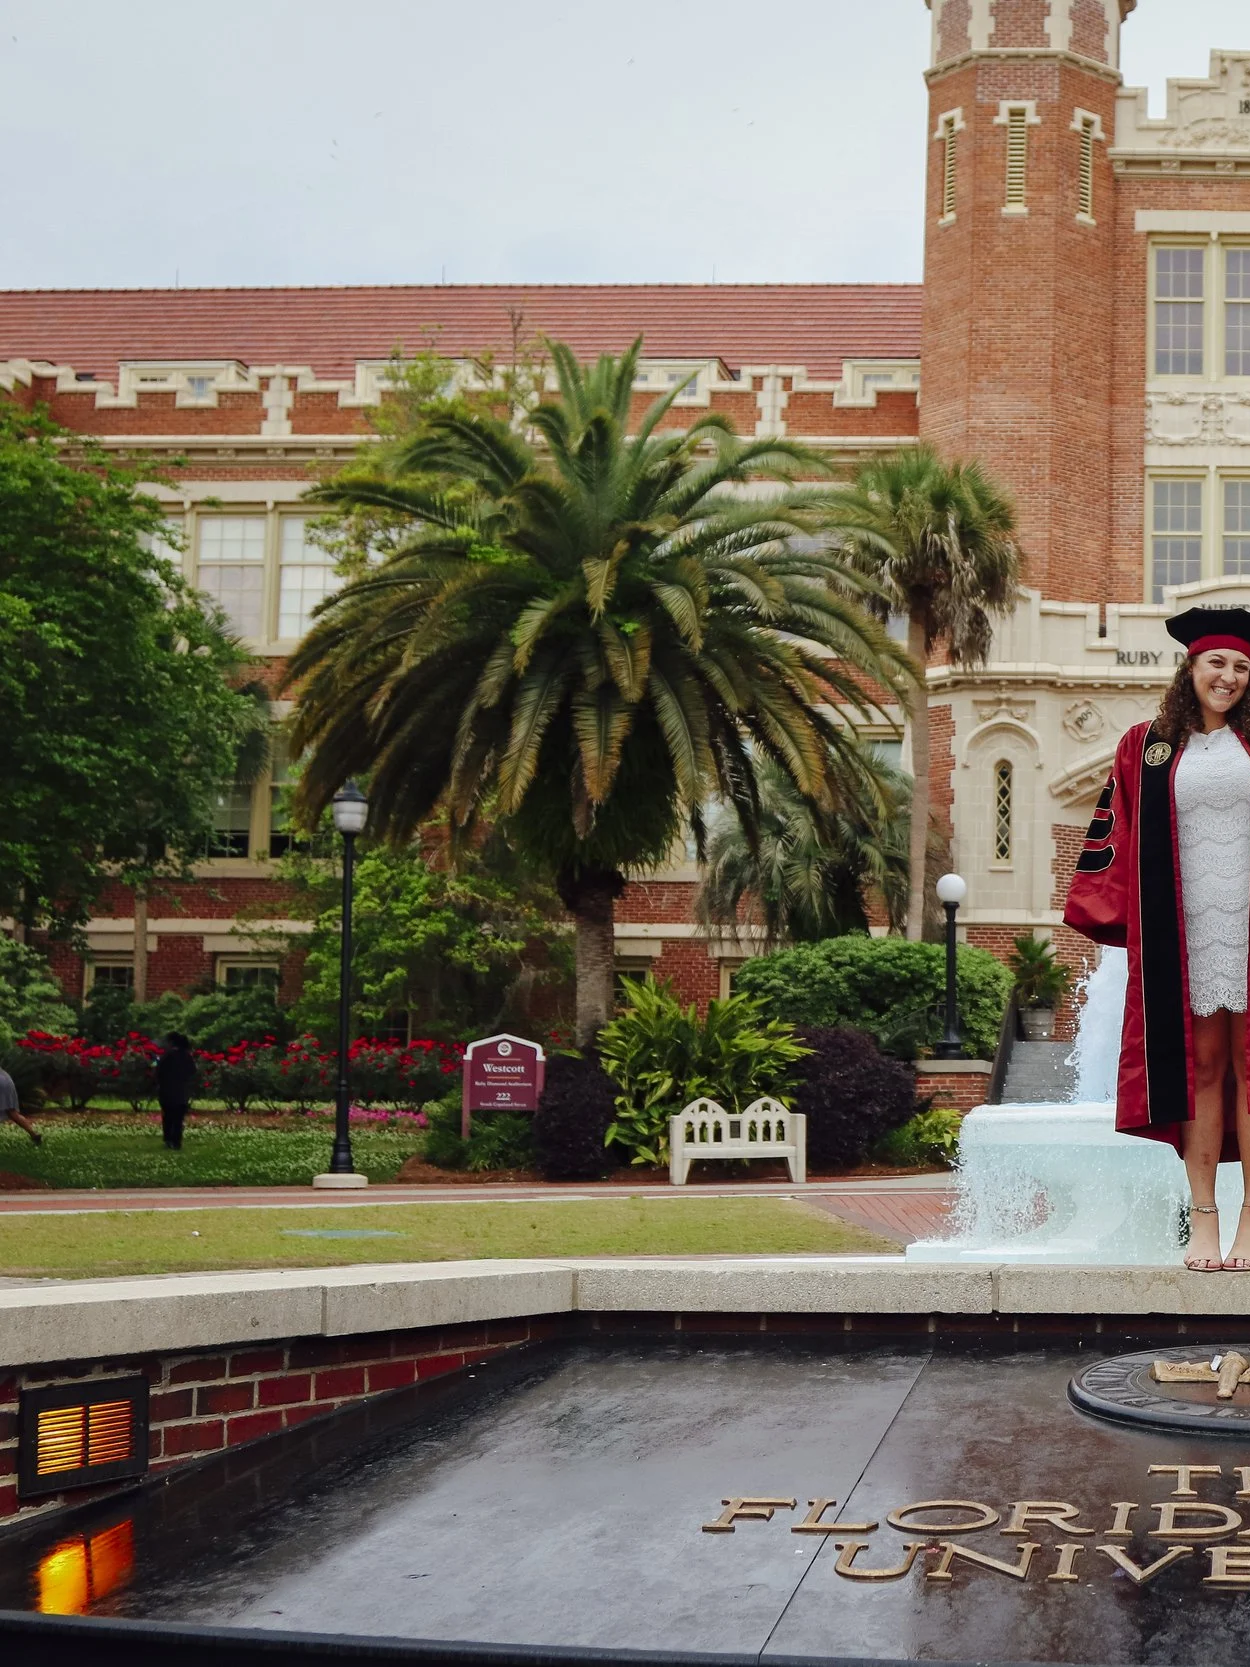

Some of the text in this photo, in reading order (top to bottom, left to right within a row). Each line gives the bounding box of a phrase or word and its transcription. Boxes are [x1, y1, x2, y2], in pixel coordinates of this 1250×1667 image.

[1116, 651, 1163, 665] RUBY
[483, 1063, 525, 1073] Westcott
[496, 1092, 511, 1101] 222
